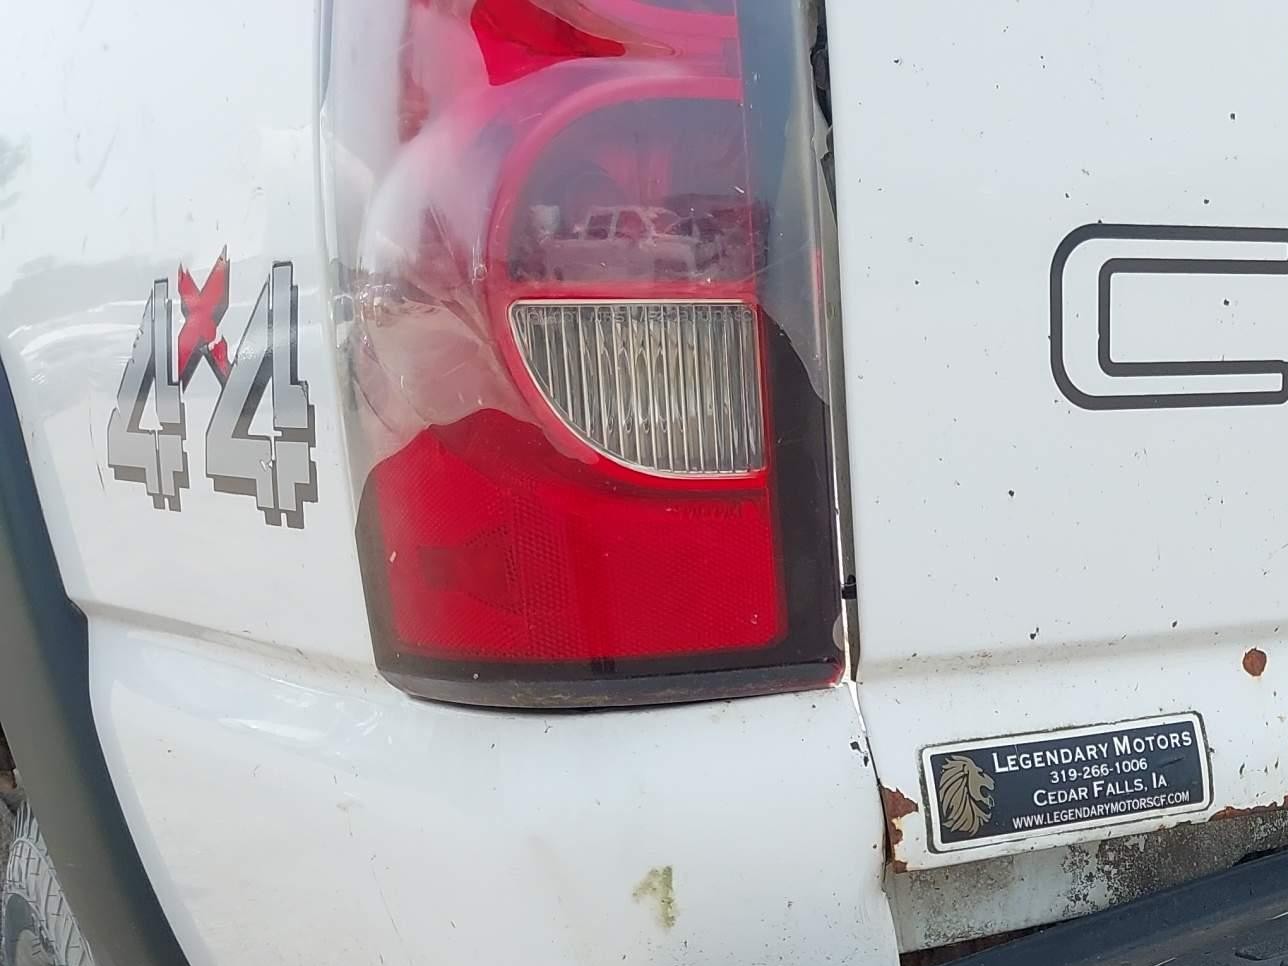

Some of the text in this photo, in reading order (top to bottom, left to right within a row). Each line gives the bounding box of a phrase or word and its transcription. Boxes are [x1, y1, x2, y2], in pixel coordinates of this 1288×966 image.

[992, 731, 1193, 774] LEGENDARY MOTORS
[1049, 758, 1148, 784] 319-266-1006
[1012, 790, 1191, 830] WWW.LEGENDARYMOTORSCF.COM
[1033, 785, 1088, 807] CEDAR
